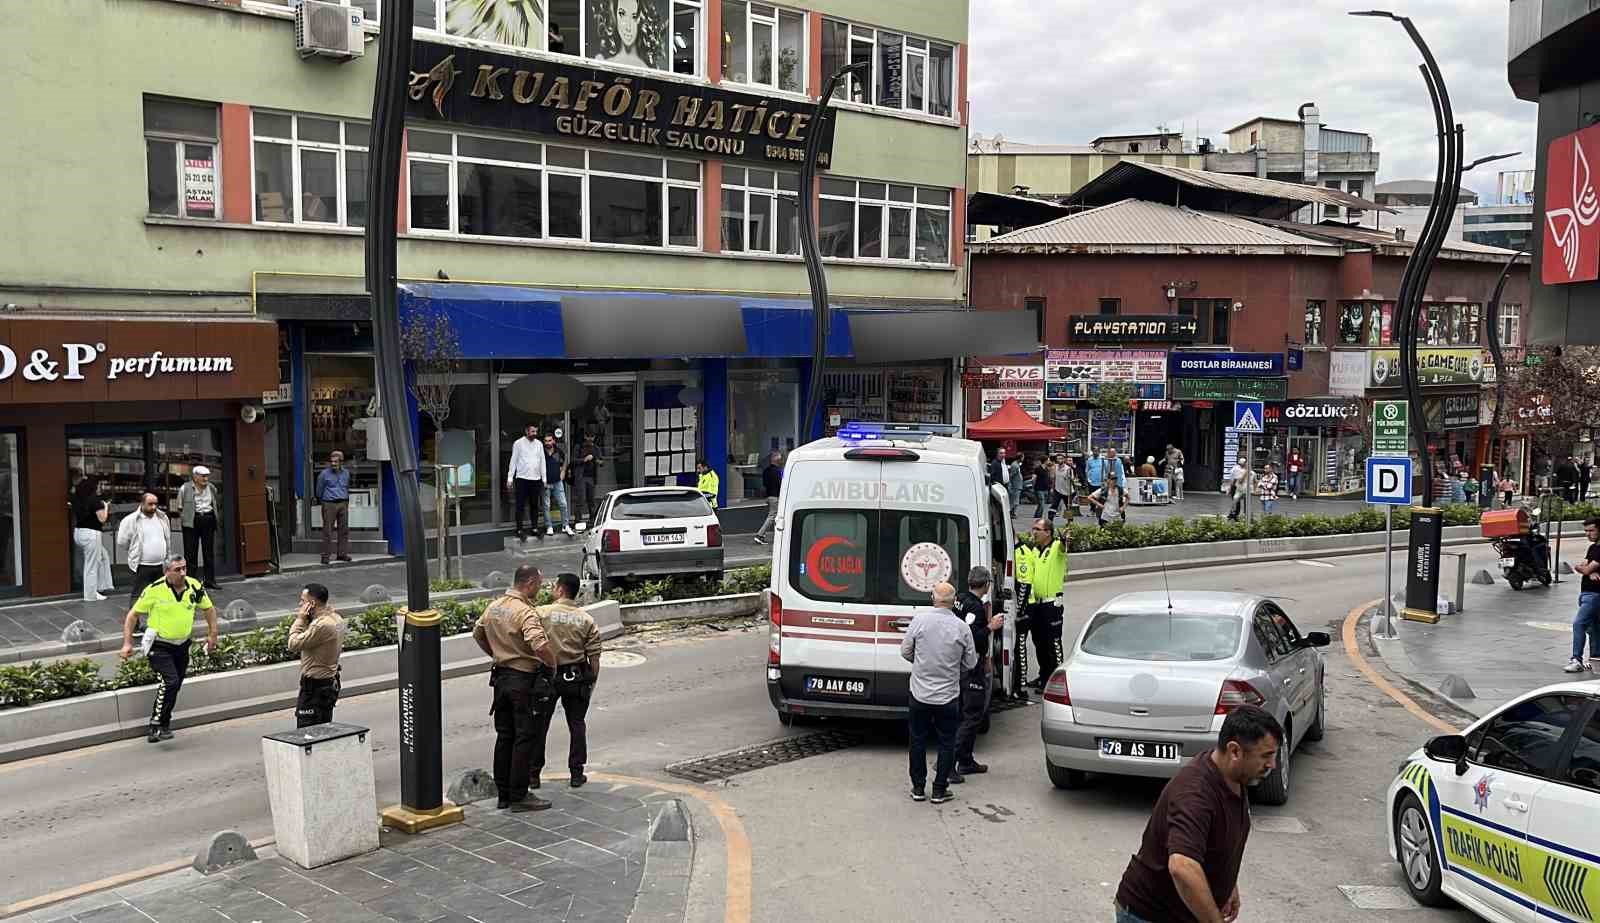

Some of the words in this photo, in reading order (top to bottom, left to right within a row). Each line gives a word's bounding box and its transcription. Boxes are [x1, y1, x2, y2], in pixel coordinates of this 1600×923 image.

[471, 64, 660, 122] KUAFÖR
[671, 96, 812, 141] HATİCE
[557, 115, 661, 146] GÜZELLİK
[666, 130, 745, 155] SALONU
[1074, 321, 1166, 335] PLAYSTATION
[107, 351, 234, 379] perfumum
[1181, 360, 1220, 369] DOSTLAR
[1221, 359, 1273, 369] BİRAHANESİ
[1428, 354, 1455, 369] GAME
[809, 480, 945, 502] AMBULANS
[1379, 469, 1398, 492] D
[811, 678, 823, 689] 78
[826, 680, 843, 691] AAV
[846, 681, 864, 692] 649
[1107, 741, 1122, 754] 78
[1130, 744, 1145, 756] AS
[1154, 745, 1174, 759] 111
[1447, 827, 1486, 867] TRAFİK
[1484, 841, 1523, 884] POLİSİ
